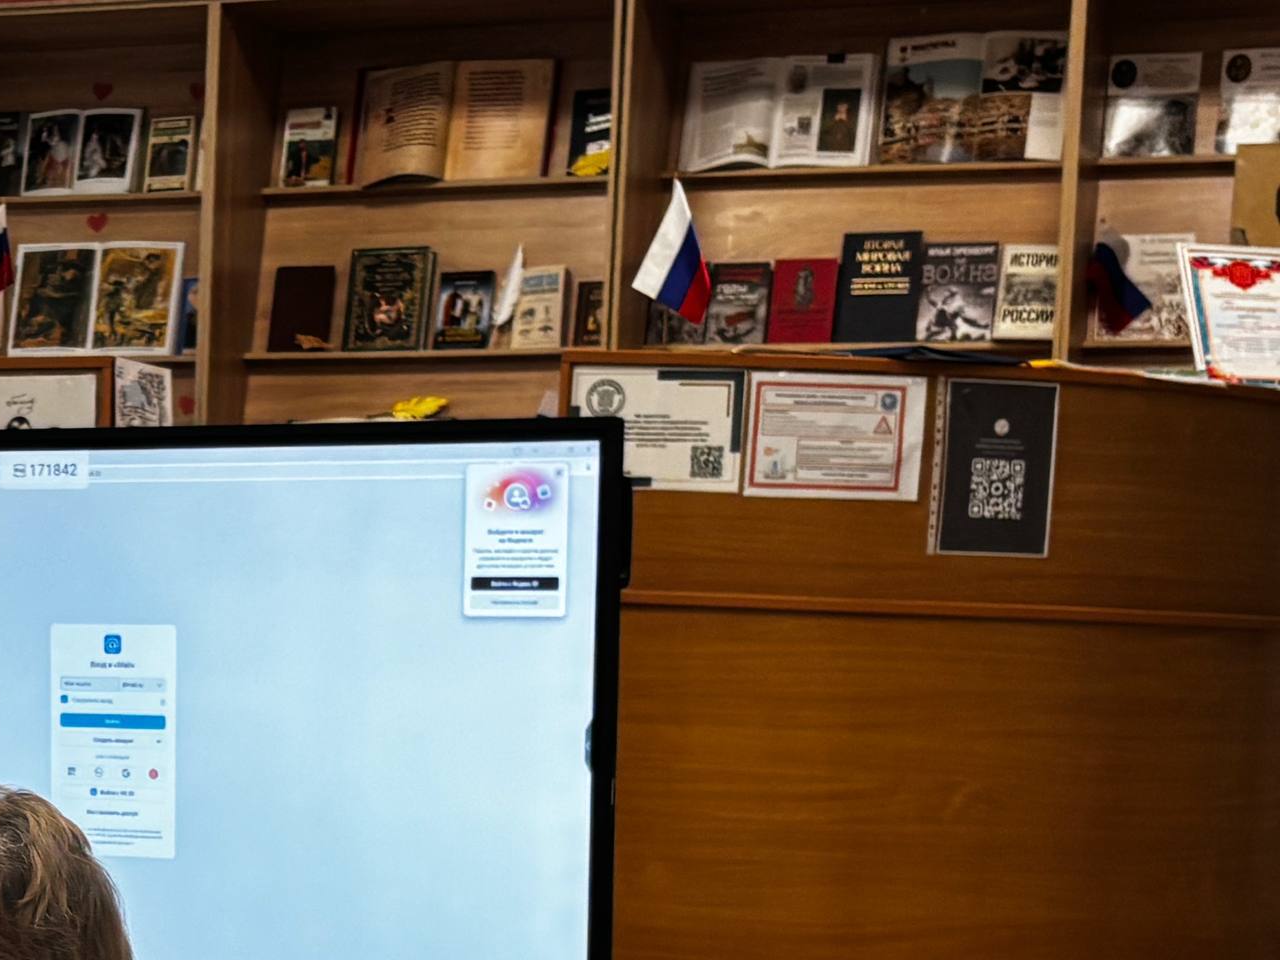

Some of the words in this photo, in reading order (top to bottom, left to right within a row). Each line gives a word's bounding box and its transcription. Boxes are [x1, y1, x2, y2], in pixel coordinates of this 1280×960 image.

[855, 250, 912, 262] МИРОВАЯ
[861, 262, 902, 274] ВОЙНА
[1002, 308, 1055, 323] РОССИИ
[30, 463, 77, 477] 171842
